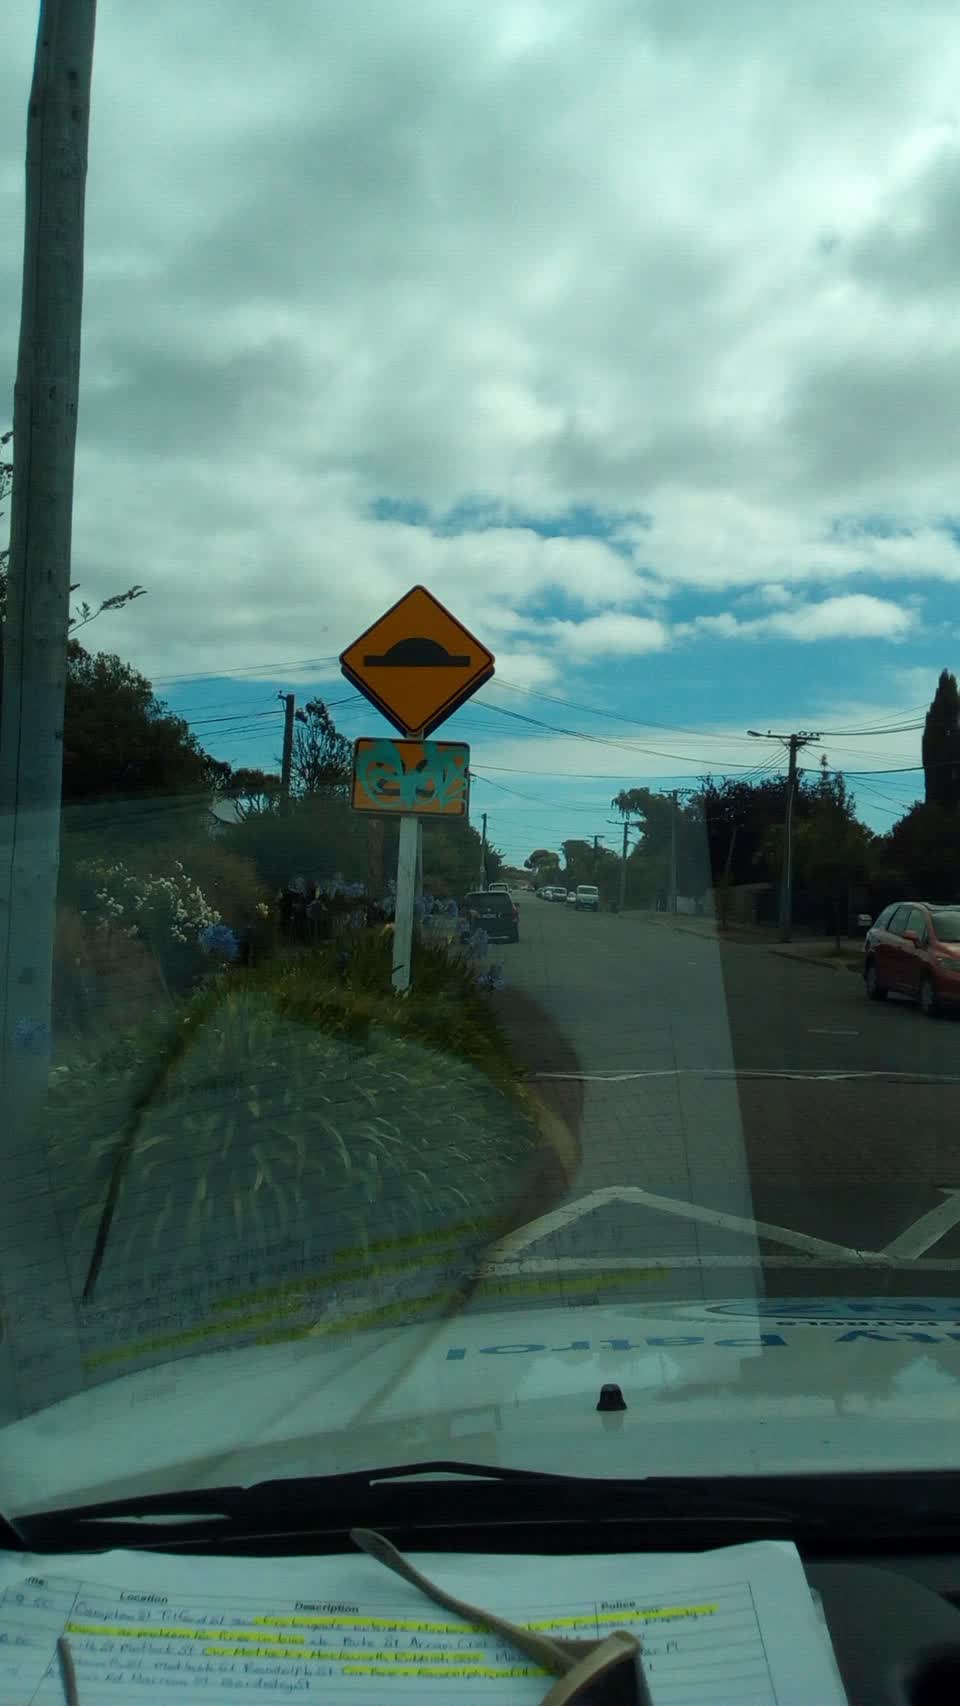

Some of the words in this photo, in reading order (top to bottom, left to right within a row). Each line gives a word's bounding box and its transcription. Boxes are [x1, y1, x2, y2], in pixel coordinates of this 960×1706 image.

[119, 1591, 169, 1605] Location
[294, 1602, 360, 1615] Description
[601, 1600, 637, 1611] Police
